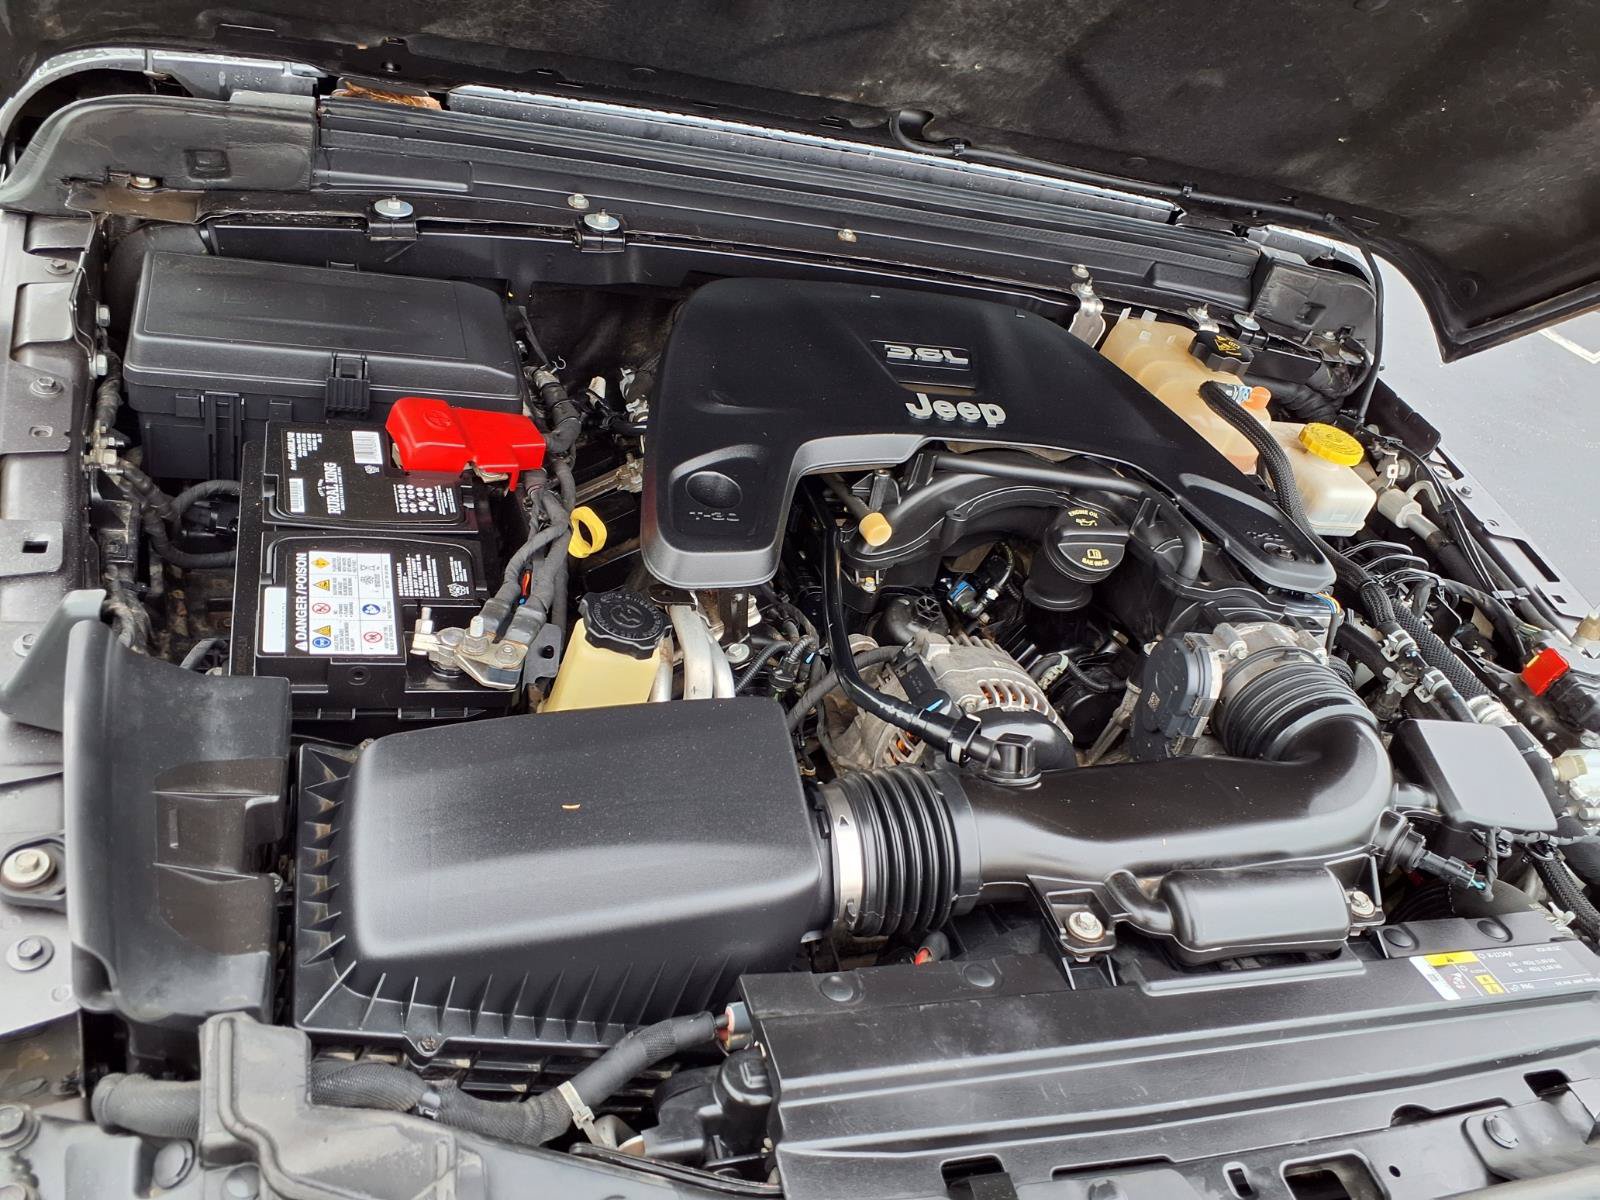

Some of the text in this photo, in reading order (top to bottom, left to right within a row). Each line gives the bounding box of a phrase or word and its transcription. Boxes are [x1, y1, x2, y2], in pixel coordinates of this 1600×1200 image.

[884, 344, 969, 365] 3.6L
[905, 393, 1007, 428] Jeep
[323, 461, 341, 514] RURAL KING
[295, 596, 308, 640] DANGER
